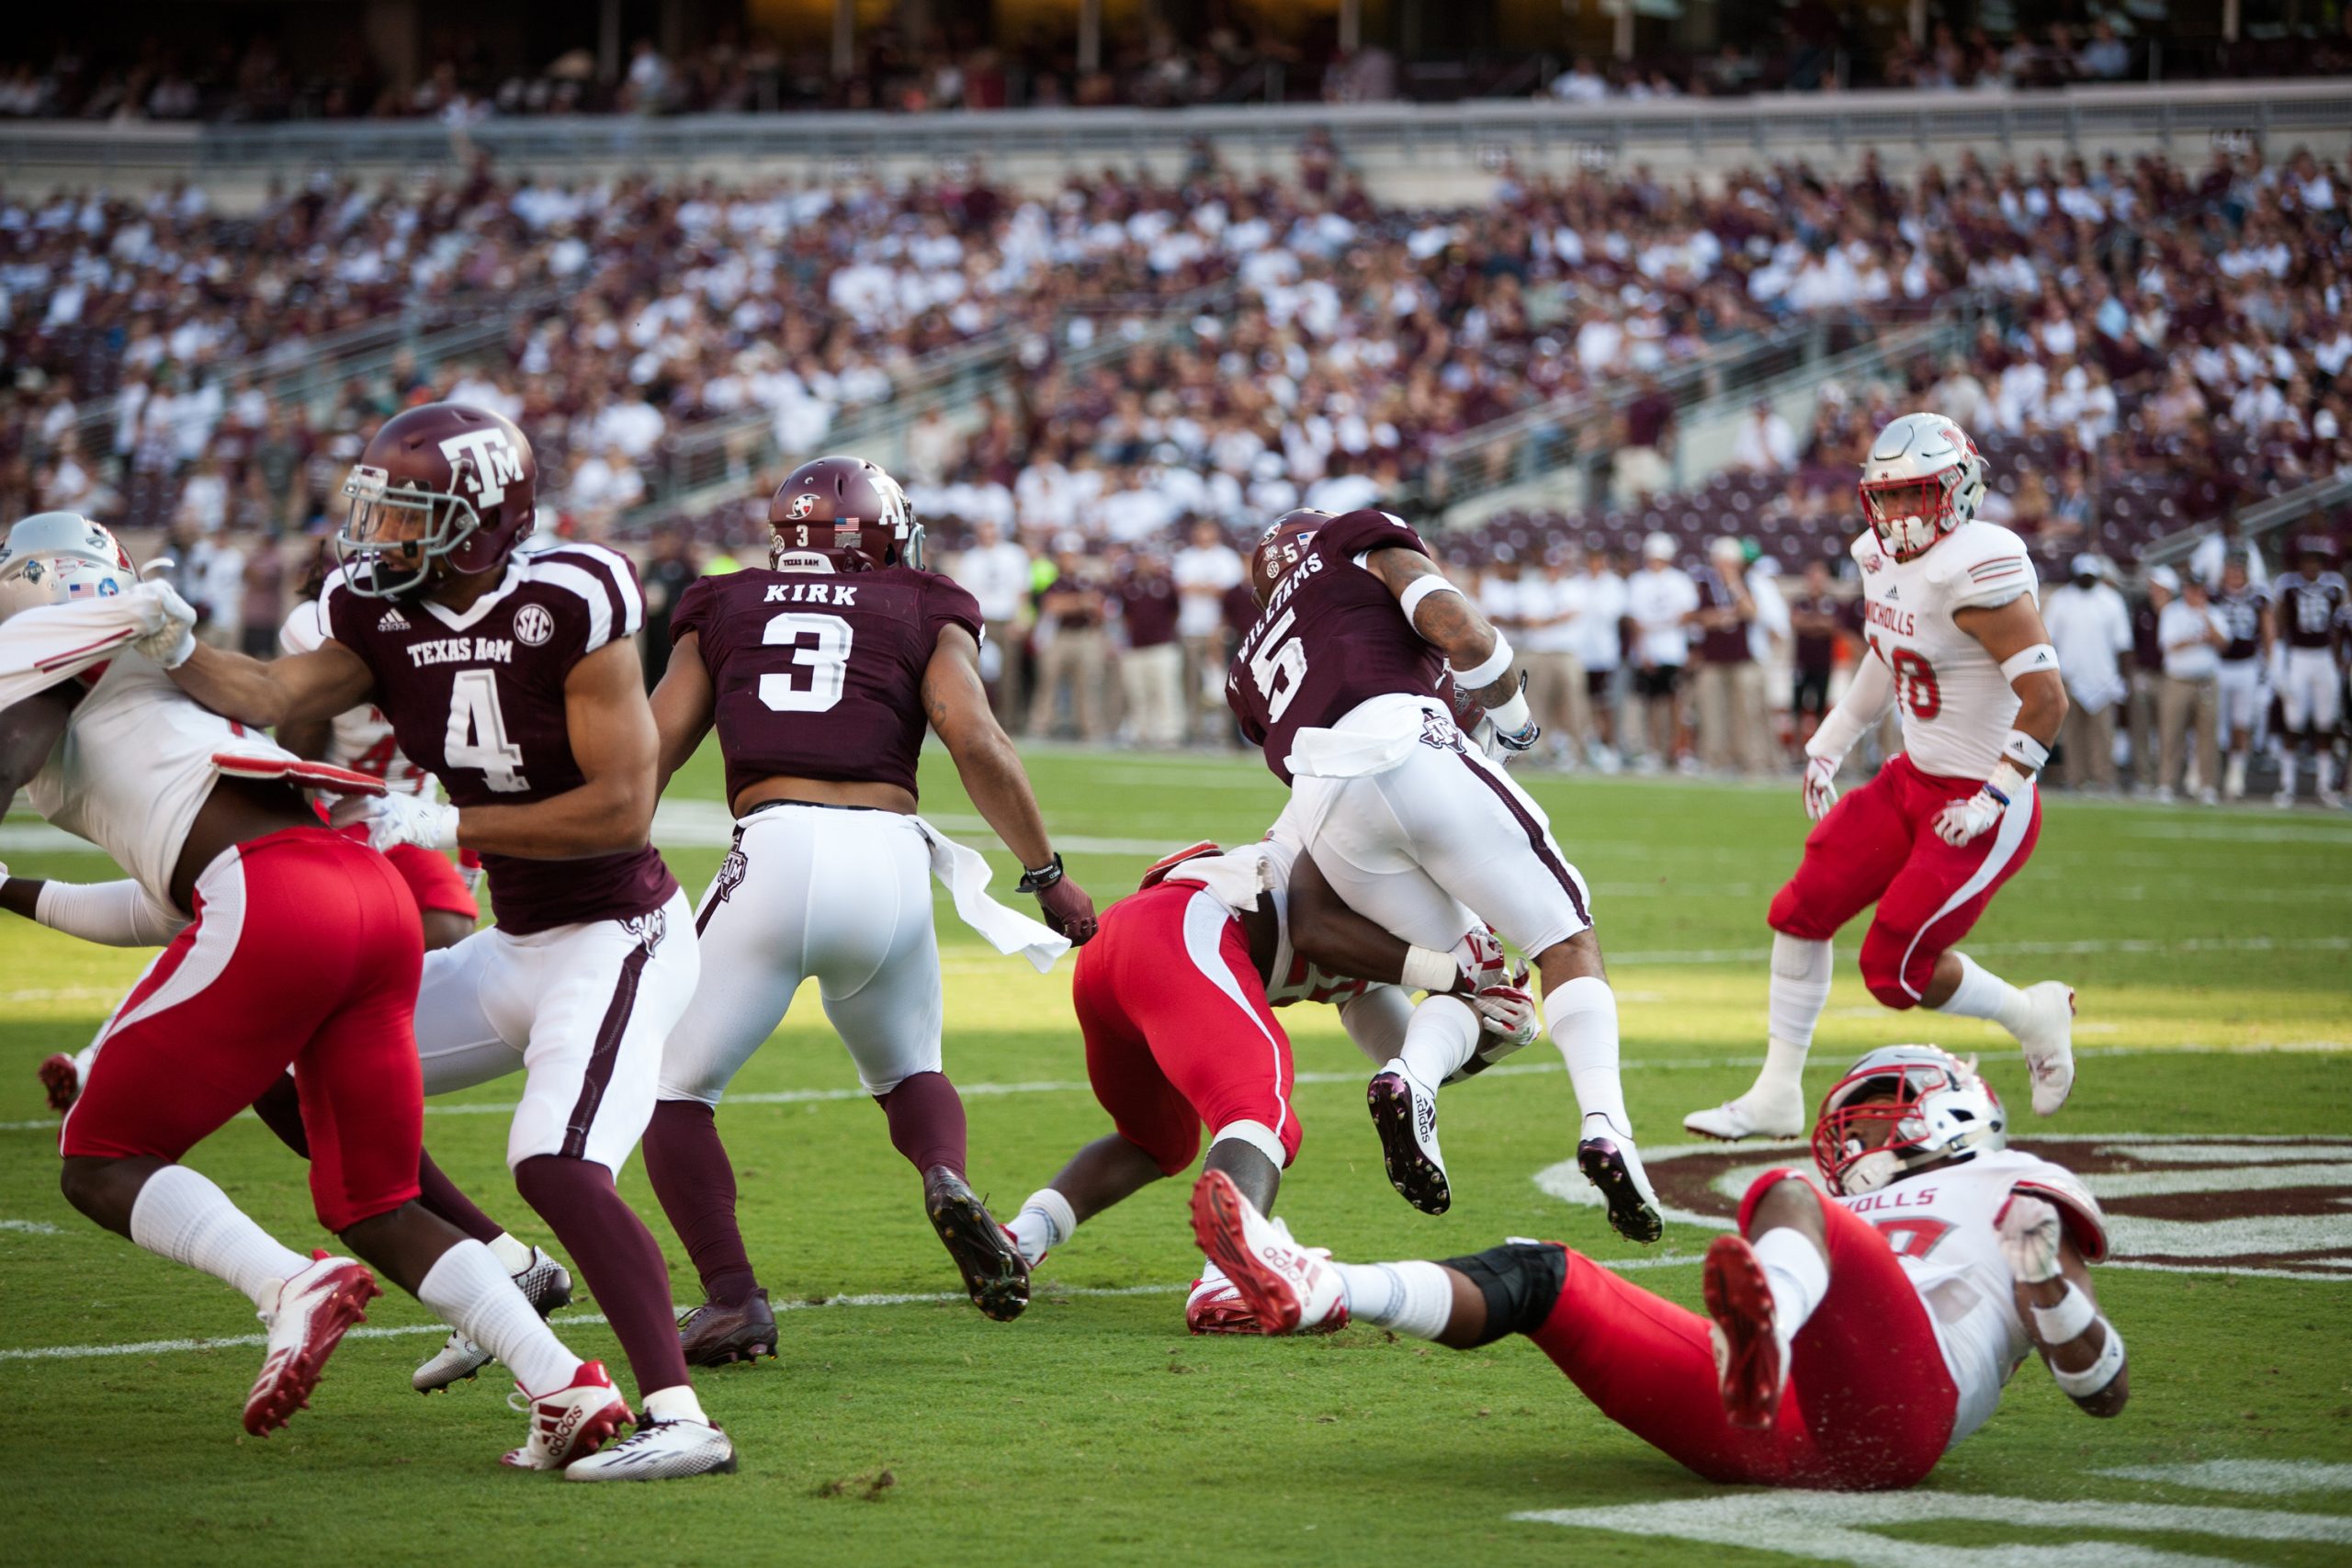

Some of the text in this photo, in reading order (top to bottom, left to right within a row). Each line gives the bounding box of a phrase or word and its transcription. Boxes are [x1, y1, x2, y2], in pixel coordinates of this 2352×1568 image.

[797, 525, 808, 547] 3
[1283, 543, 1298, 563] 5
[784, 558, 802, 567] TEXAS
[763, 584, 857, 606] KIRK
[1238, 552, 1323, 663] WILLIAMS
[378, 621, 412, 632] adidas
[515, 605, 551, 644] SEC
[1865, 599, 1915, 637] NICHOLLS
[406, 637, 514, 668] TEXAS A&M
[758, 612, 854, 713] 3
[1250, 606, 1308, 724] 5
[444, 668, 532, 794] 4
[1415, 1093, 1430, 1144] adidas
[1263, 1247, 1311, 1308] adidas
[548, 1404, 583, 1457] adidas
